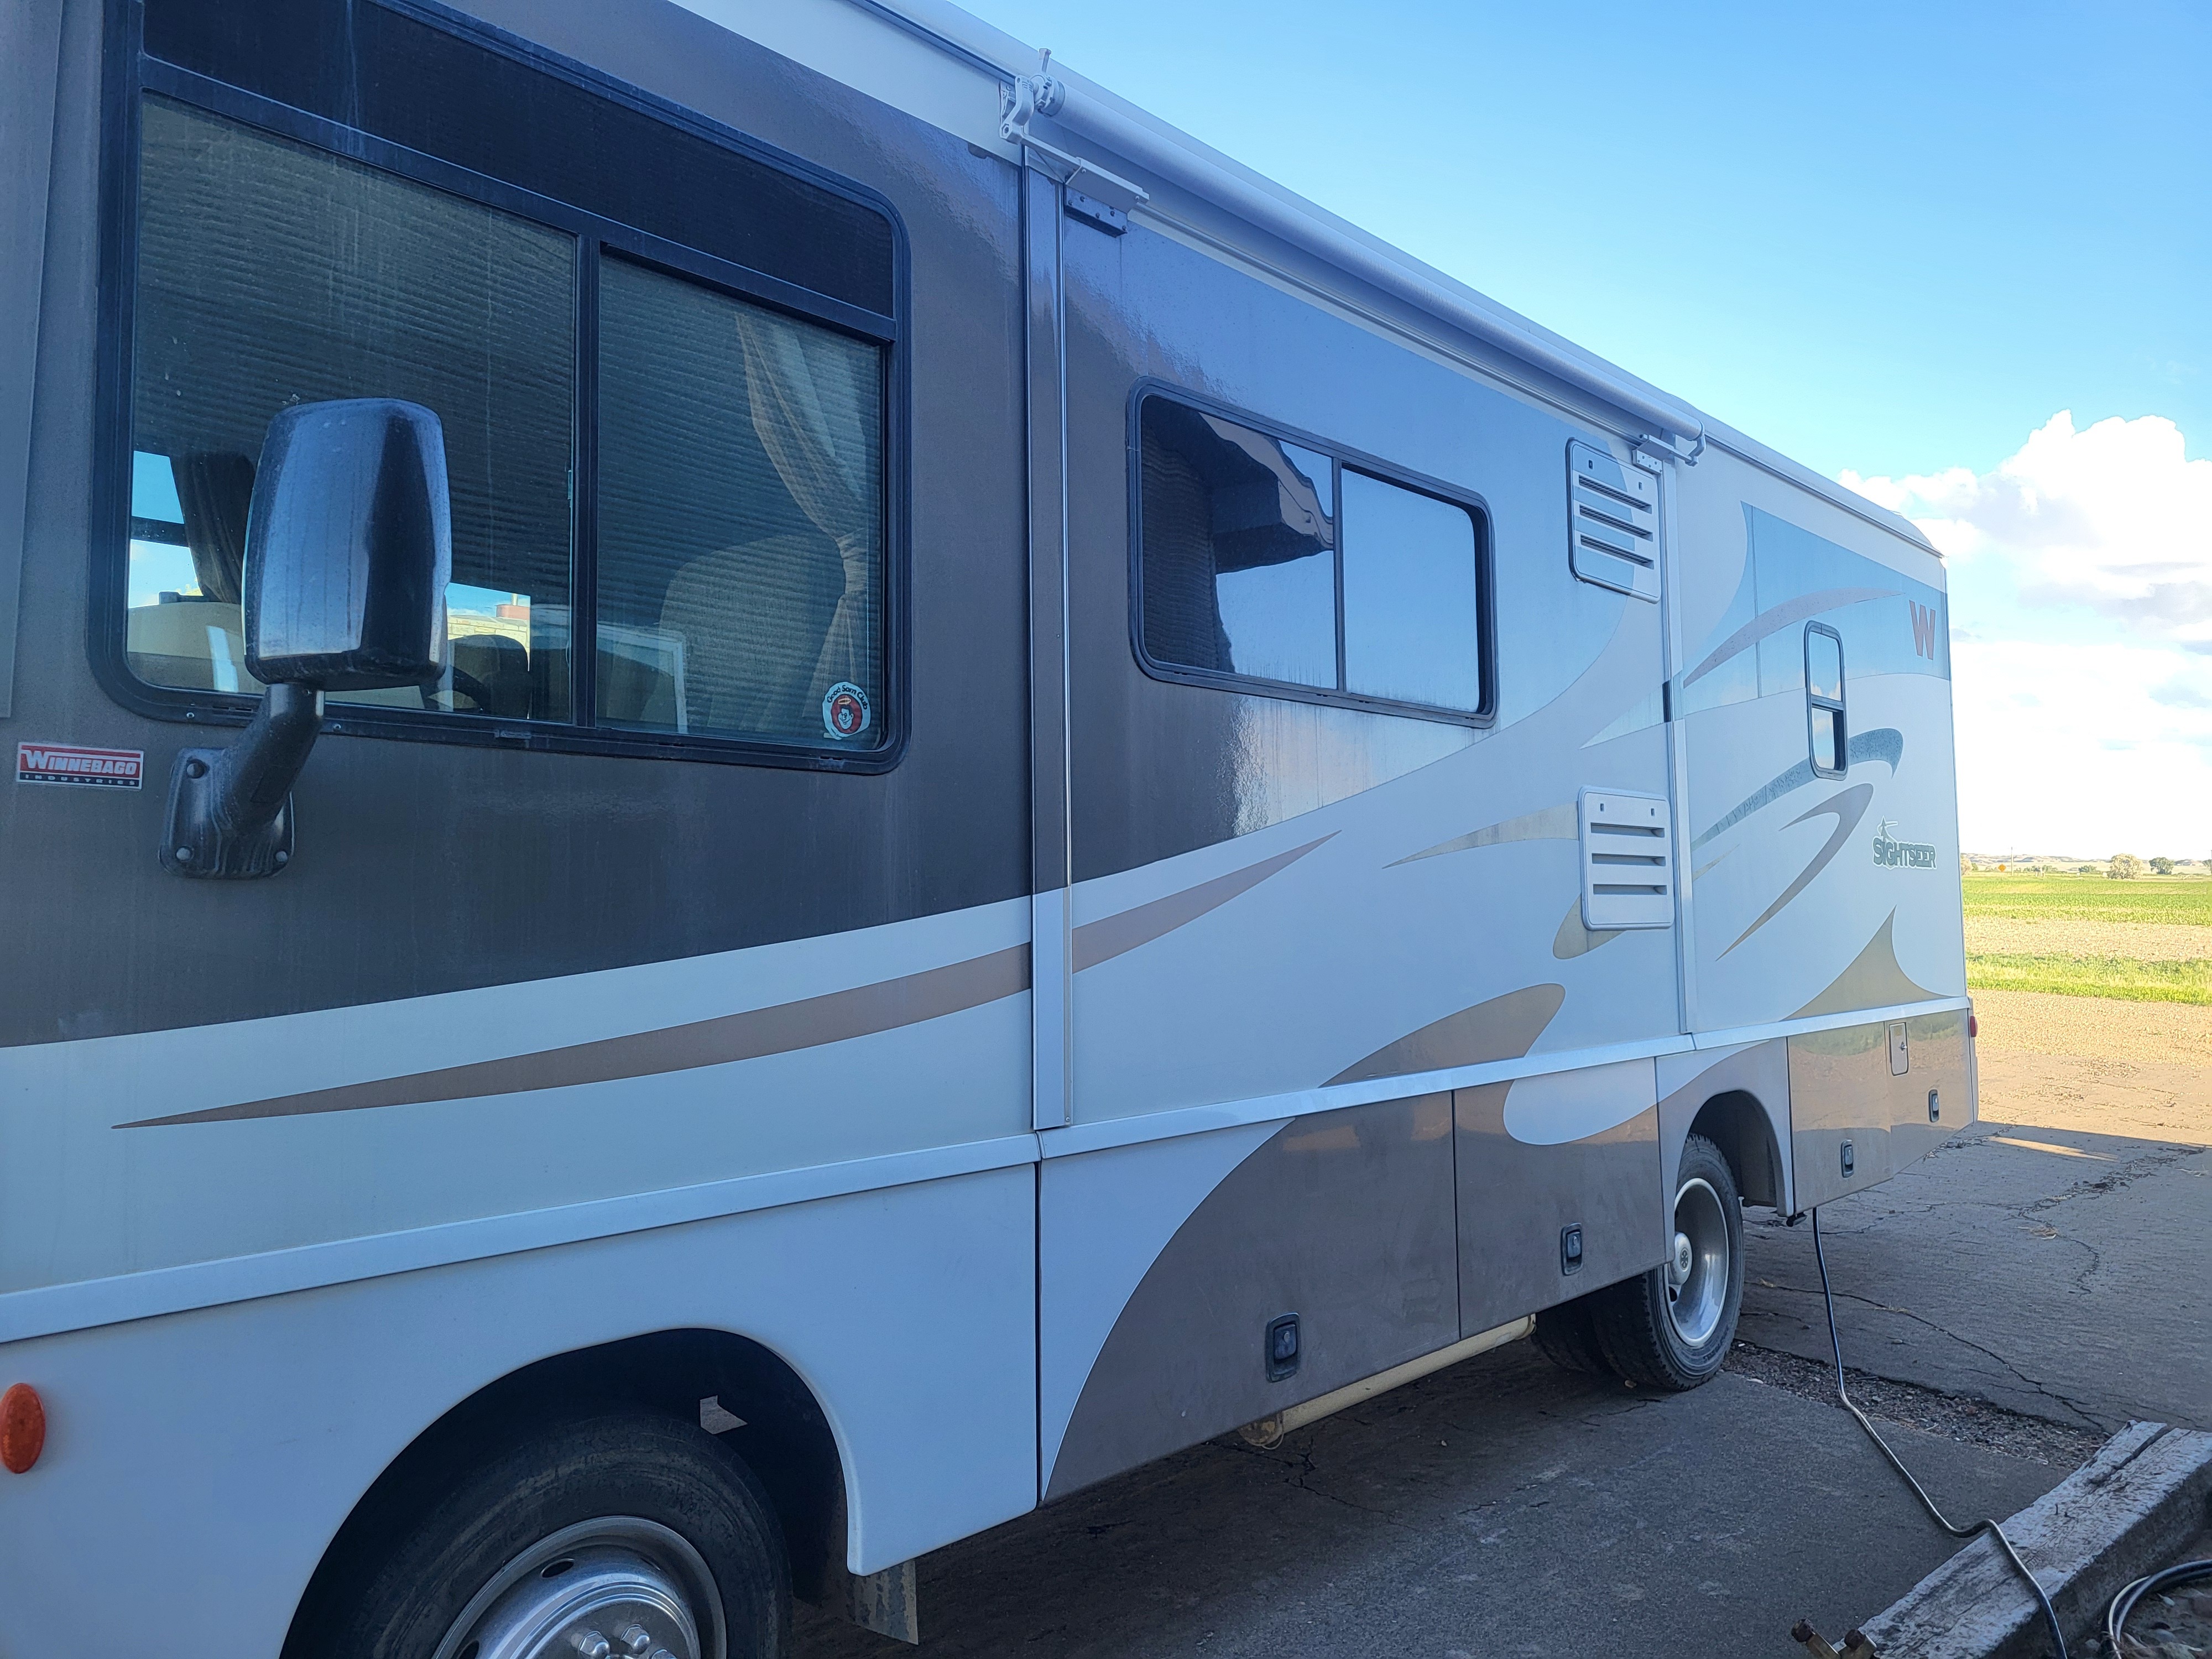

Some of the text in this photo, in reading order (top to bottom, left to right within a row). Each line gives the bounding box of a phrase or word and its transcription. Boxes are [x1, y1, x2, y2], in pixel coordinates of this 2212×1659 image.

[1909, 599, 1936, 660] W
[827, 685, 868, 709] Good Sam Club
[26, 750, 137, 775] WINNEBAGO
[25, 774, 135, 785] INDUSTRIES
[1873, 837, 1937, 868] SIGHTSEER
